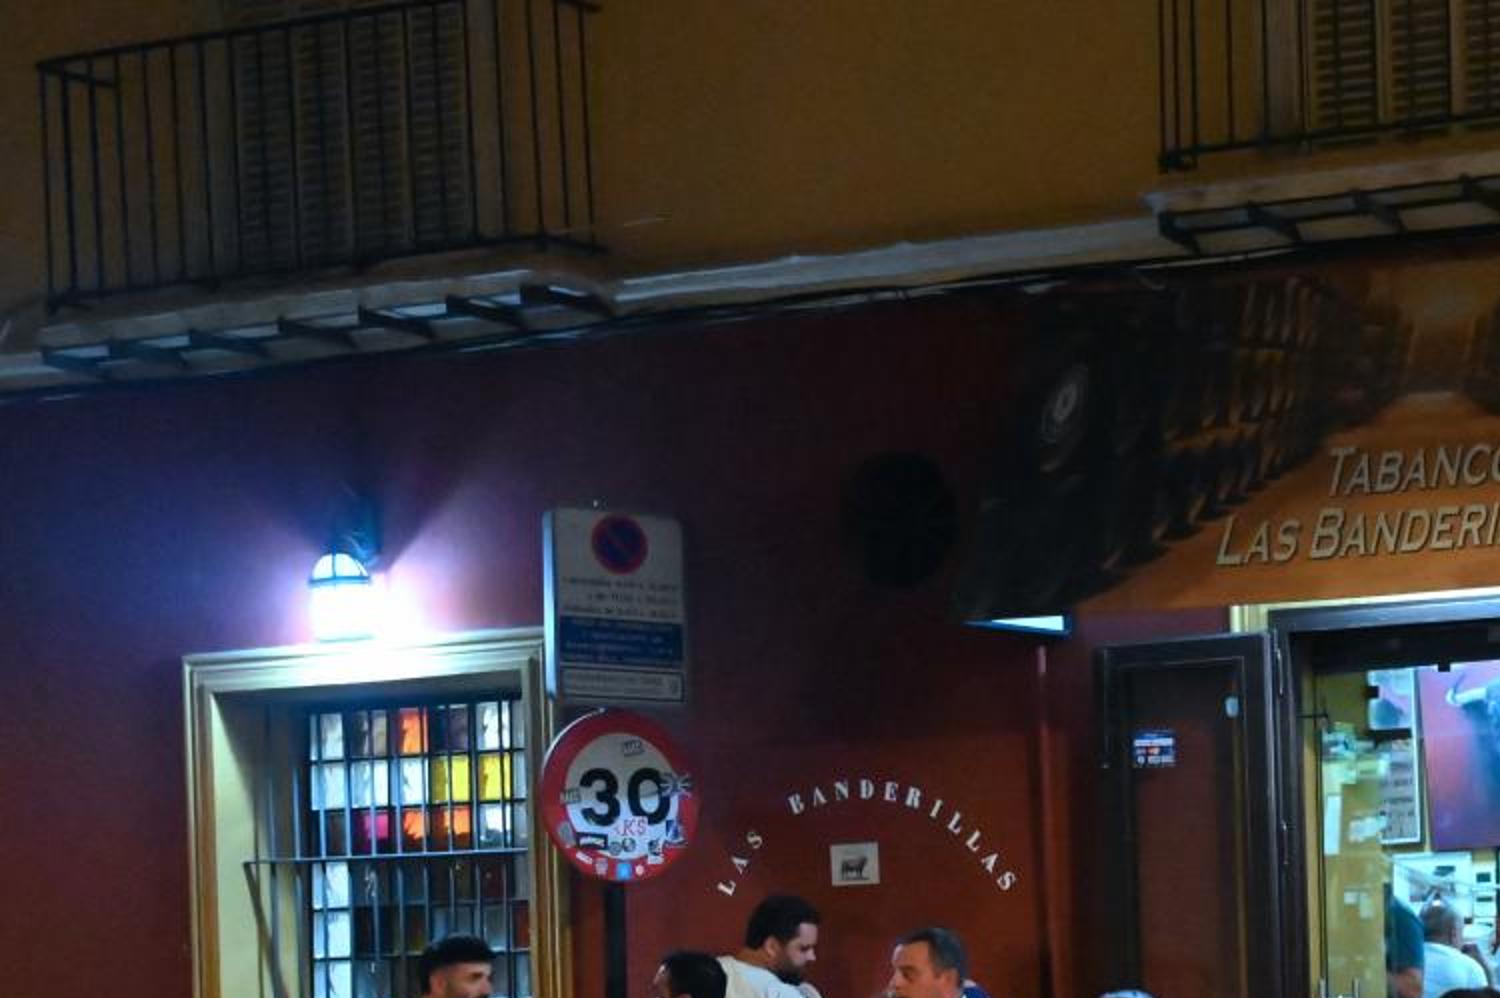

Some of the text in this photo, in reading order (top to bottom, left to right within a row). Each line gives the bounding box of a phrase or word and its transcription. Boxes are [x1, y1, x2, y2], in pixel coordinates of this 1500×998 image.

[1215, 510, 1301, 567] LAS
[580, 767, 670, 826] 30
[717, 778, 1017, 896] LAS BANDERILLAS
